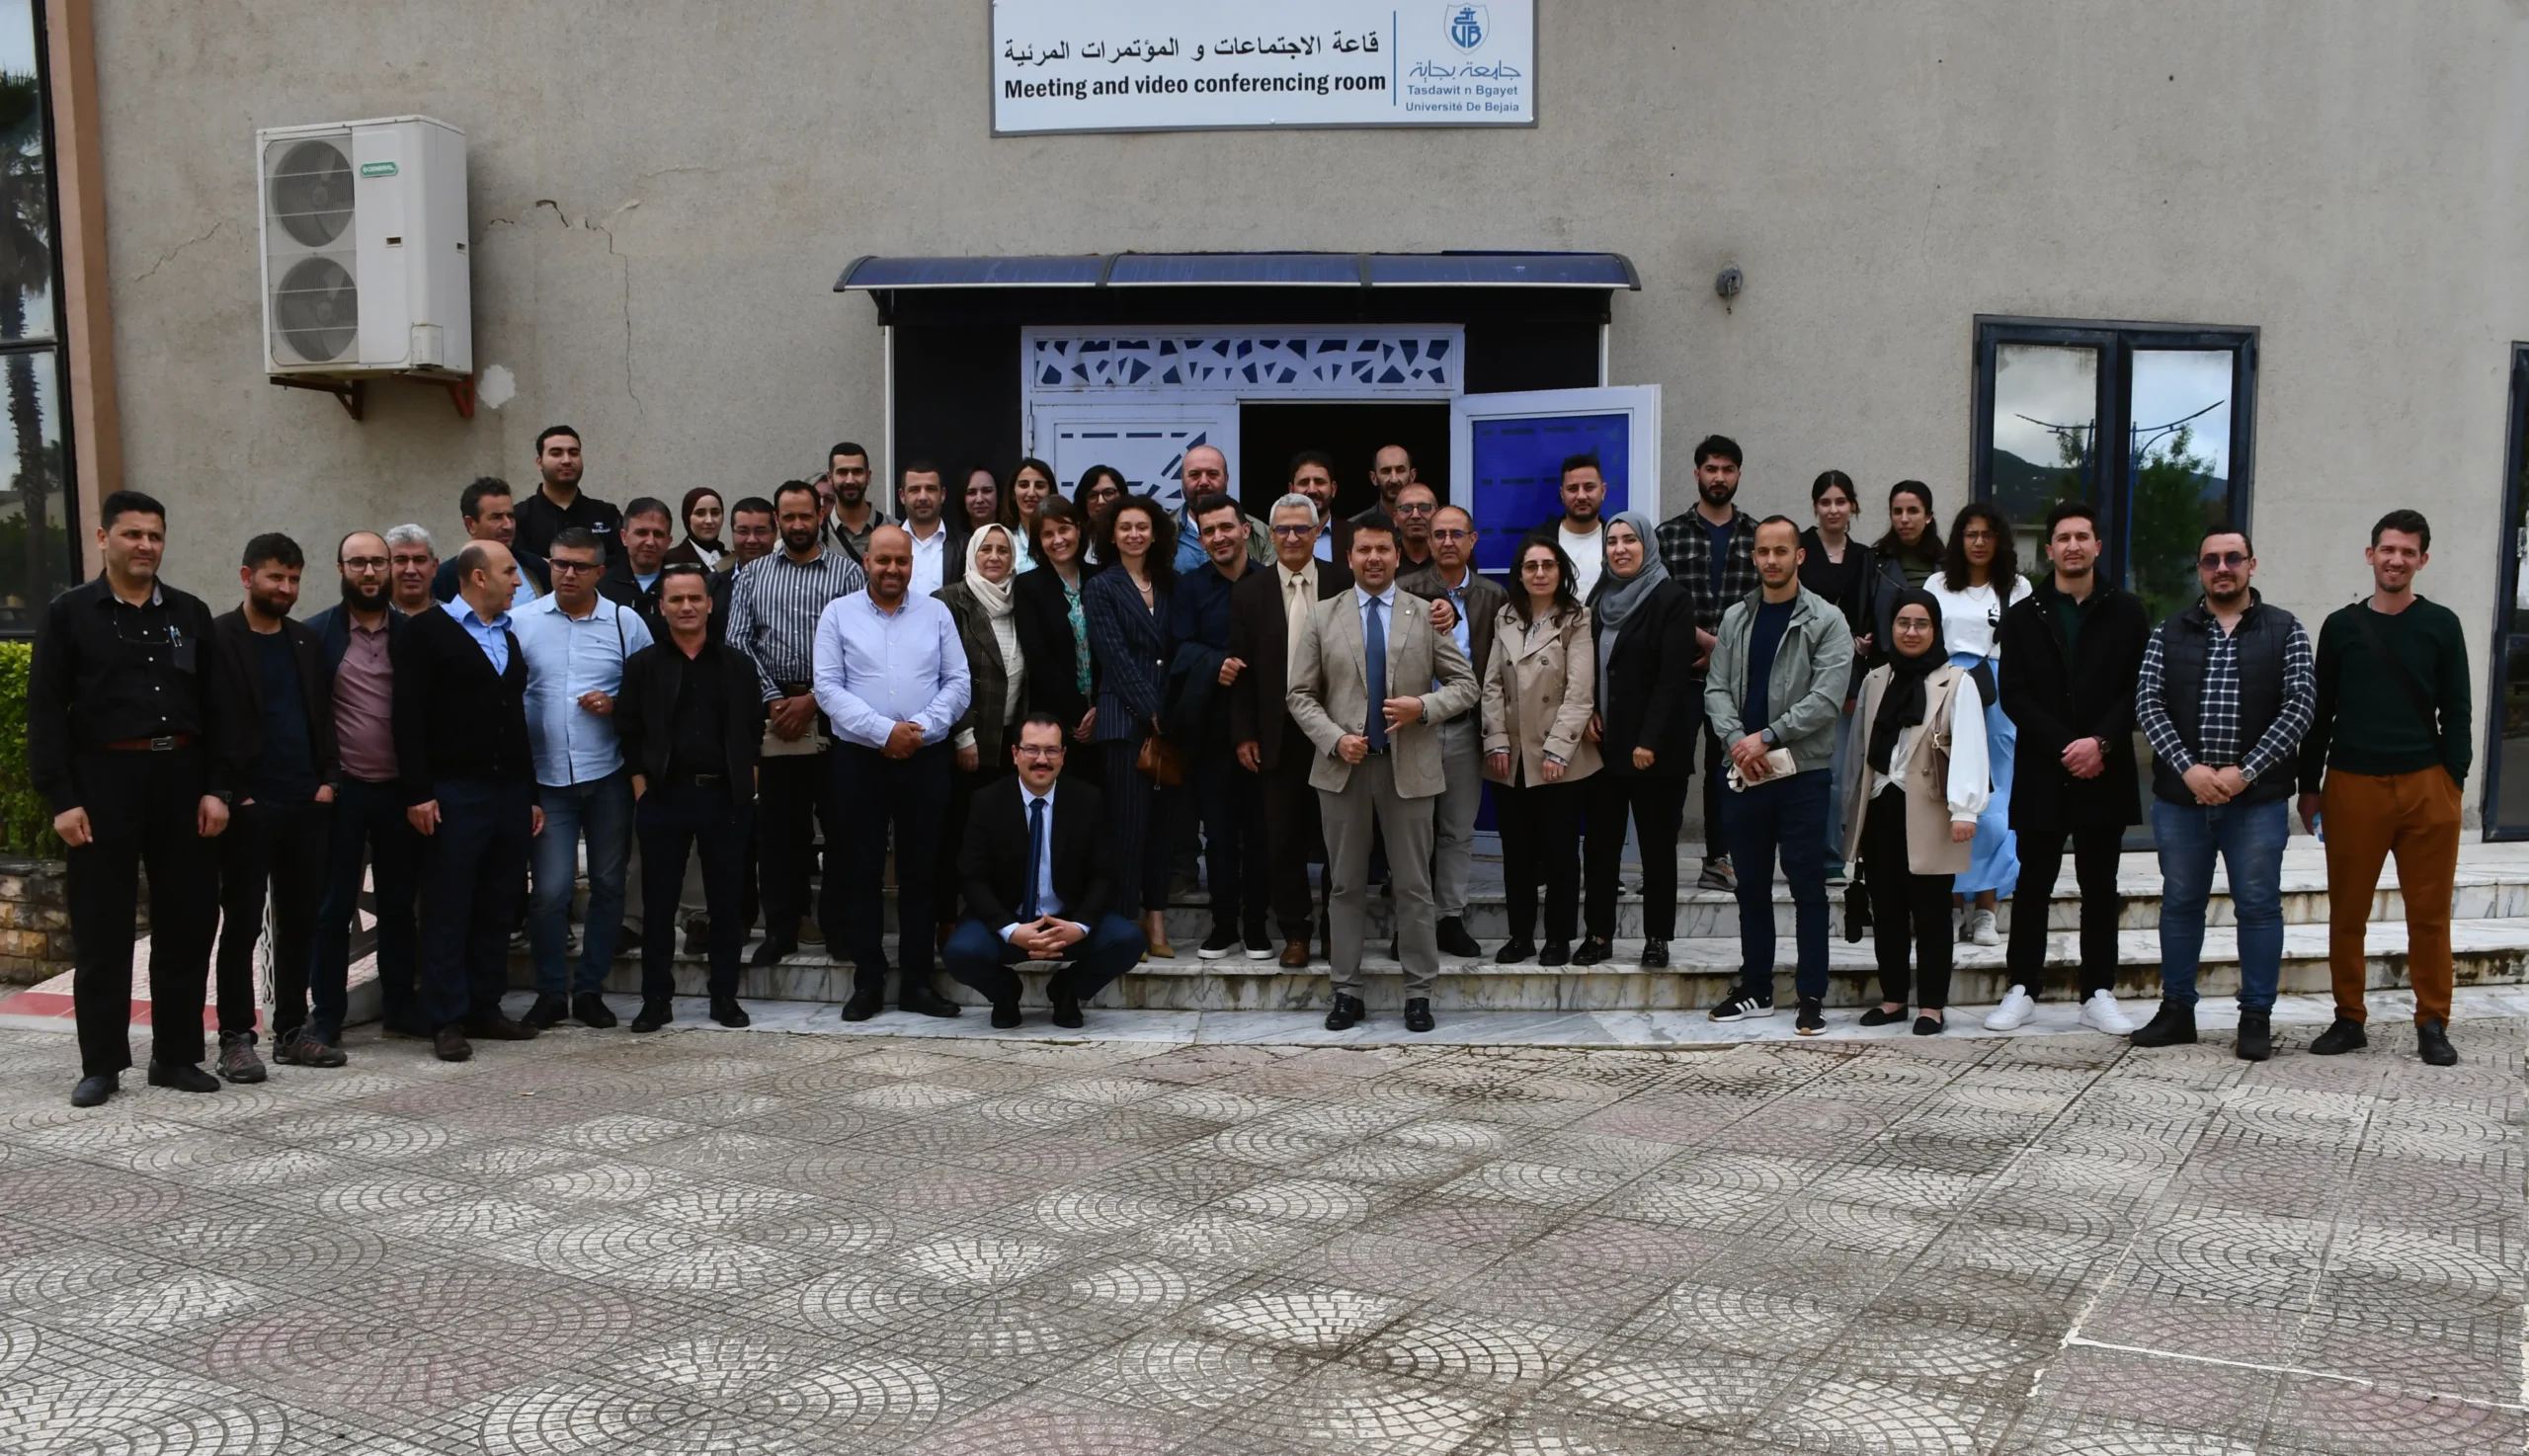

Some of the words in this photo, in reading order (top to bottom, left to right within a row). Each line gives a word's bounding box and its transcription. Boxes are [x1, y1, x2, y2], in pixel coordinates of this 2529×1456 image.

[1004, 39, 1070, 67] المرئية
[1081, 36, 1180, 64] المؤتمرات
[1189, 43, 1205, 62] و
[1213, 36, 1322, 60] الاجتماعات
[1332, 30, 1379, 53] قاعة
[1409, 59, 1456, 83] بجاية
[1459, 59, 1521, 81] جامعة
[1005, 78, 1088, 100] Meeting
[1092, 75, 1129, 95] and
[1134, 74, 1188, 94] video
[1193, 72, 1330, 96] conferencing
[1335, 75, 1386, 91] room
[1407, 84, 1461, 96] Tasdawit
[1464, 86, 1472, 96] n
[1476, 84, 1518, 98] Bgayet
[1406, 101, 1463, 112] Université
[1466, 101, 1481, 112] De
[1485, 101, 1519, 114] Bejaia
